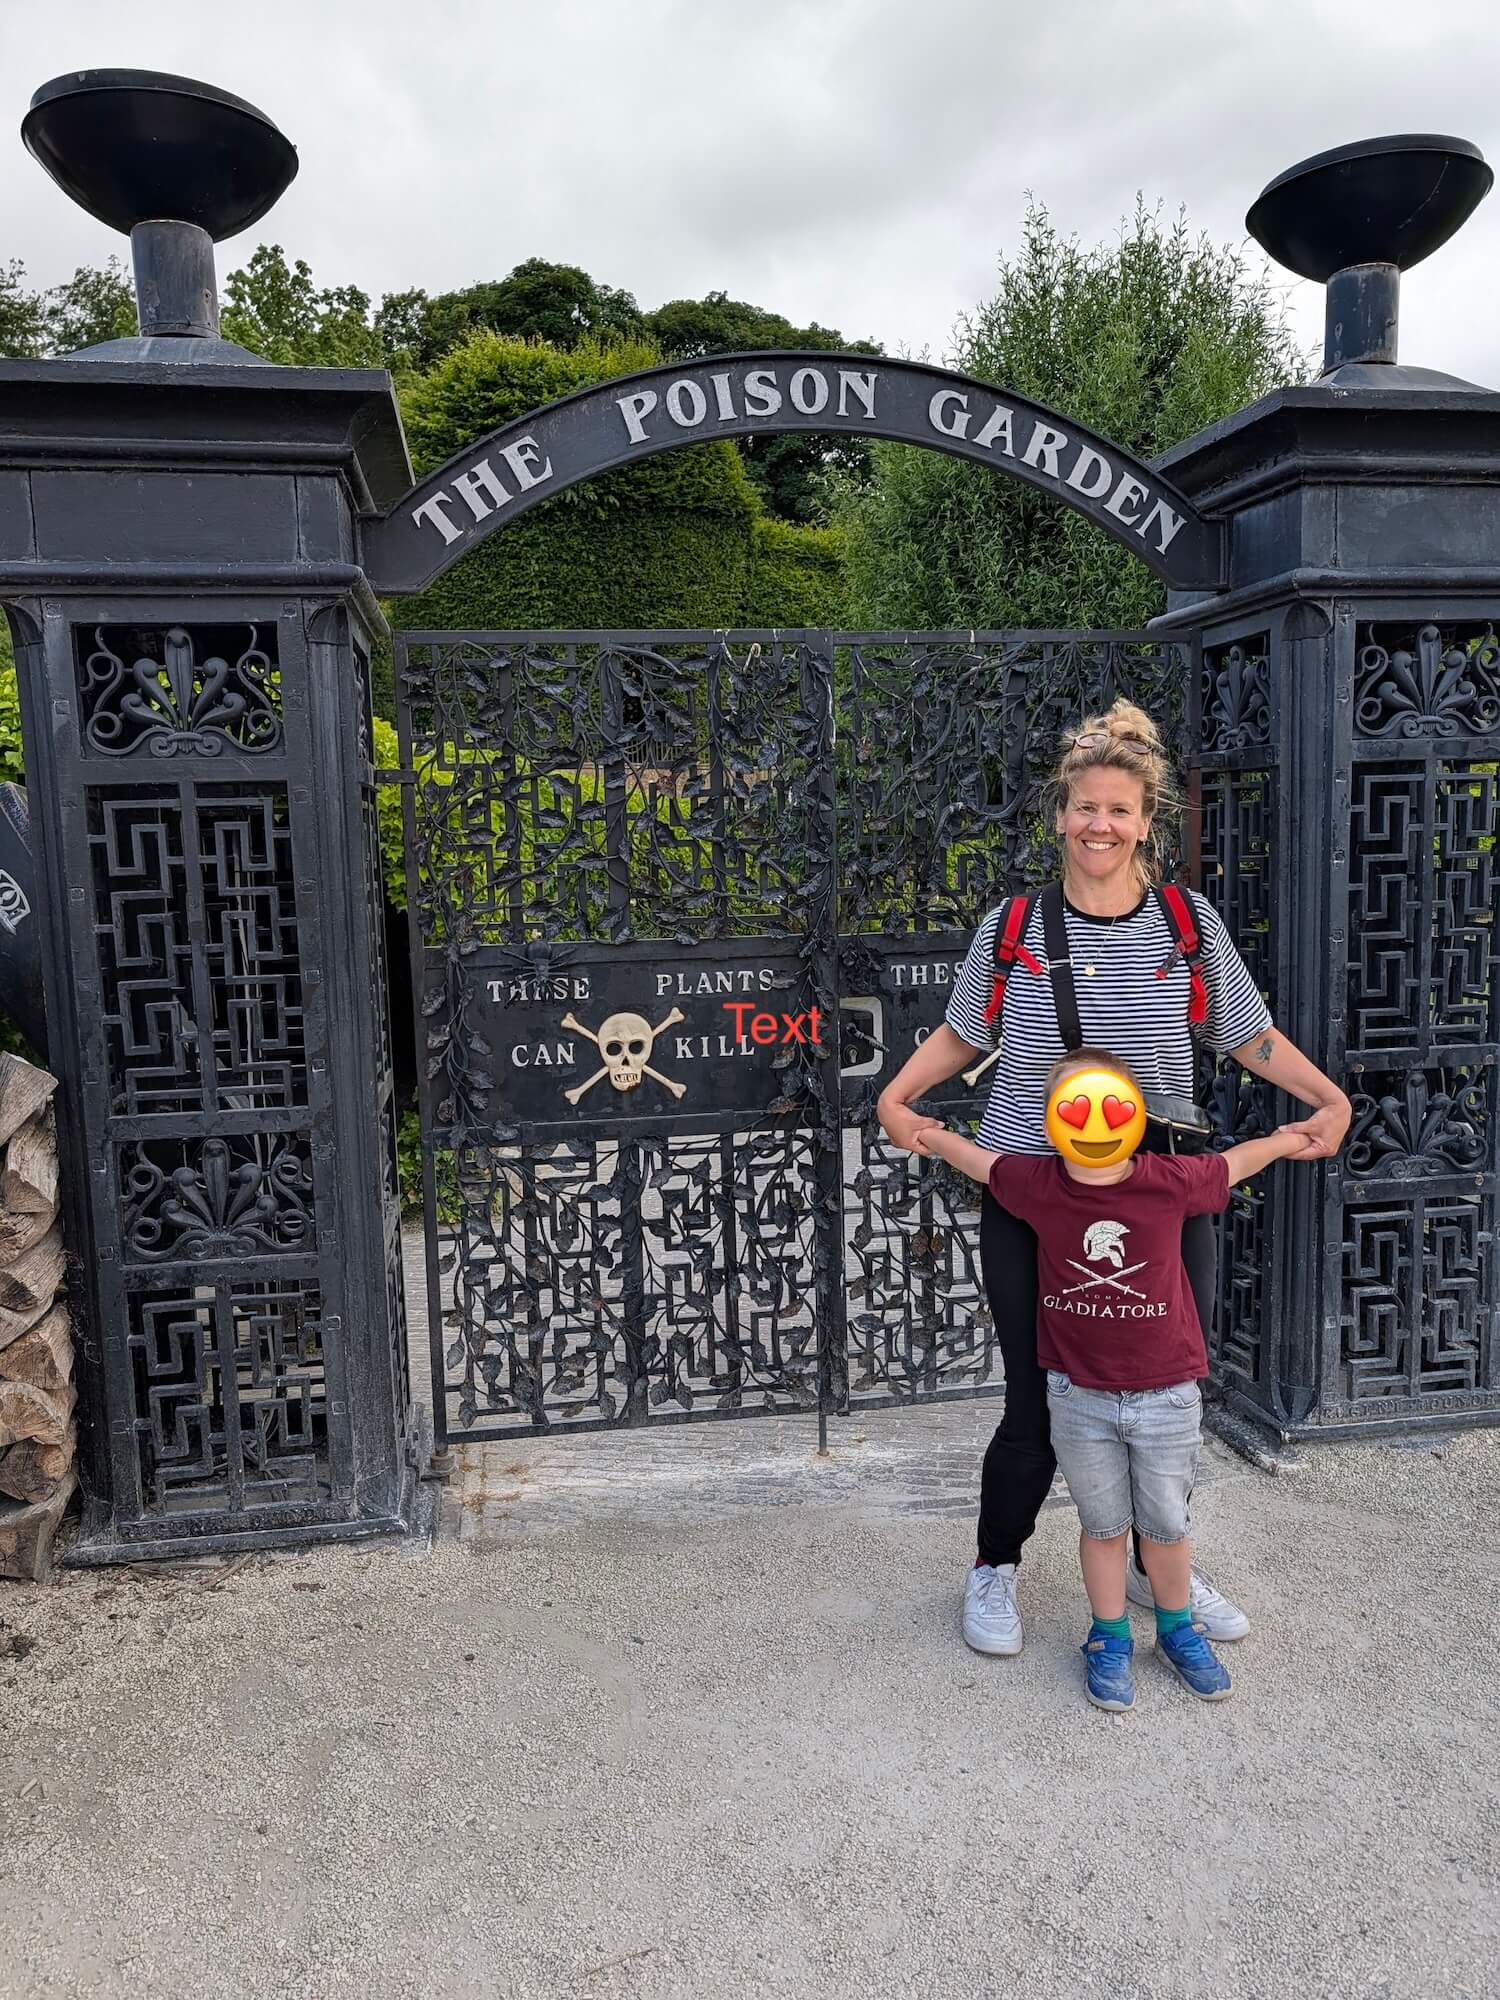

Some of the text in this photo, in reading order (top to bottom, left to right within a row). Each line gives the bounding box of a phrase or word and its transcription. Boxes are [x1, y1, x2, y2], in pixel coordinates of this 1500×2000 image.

[411, 367, 1187, 555] THE POISON GARDEN
[656, 968, 775, 995] PLANTS
[890, 962, 965, 986] THE
[511, 1034, 755, 1068] CAN KILL
[1043, 1295, 1168, 1319] GLADIATORE
